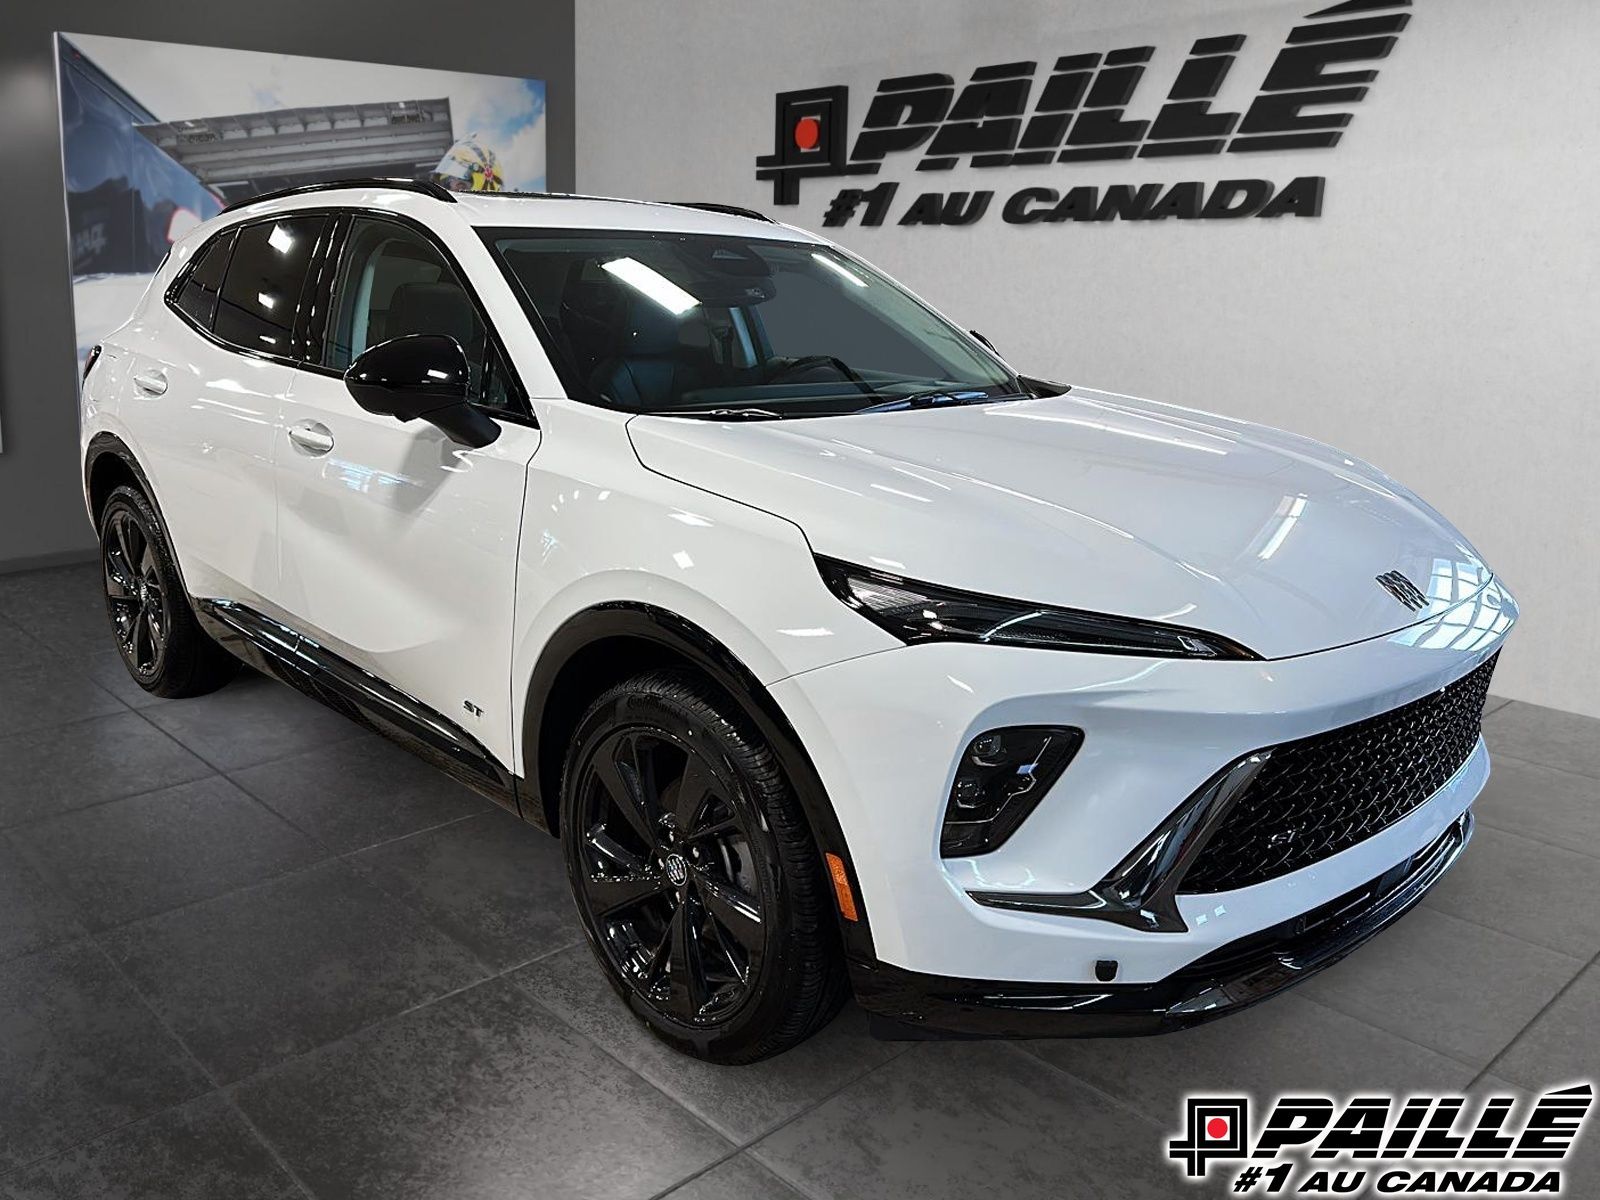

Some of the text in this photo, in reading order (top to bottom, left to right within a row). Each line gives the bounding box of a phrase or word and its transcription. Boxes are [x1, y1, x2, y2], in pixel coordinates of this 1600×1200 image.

[848, 0, 1412, 172] PAILLÉ
[822, 176, 1326, 228] #1 AU CANADA
[463, 700, 484, 717] ST
